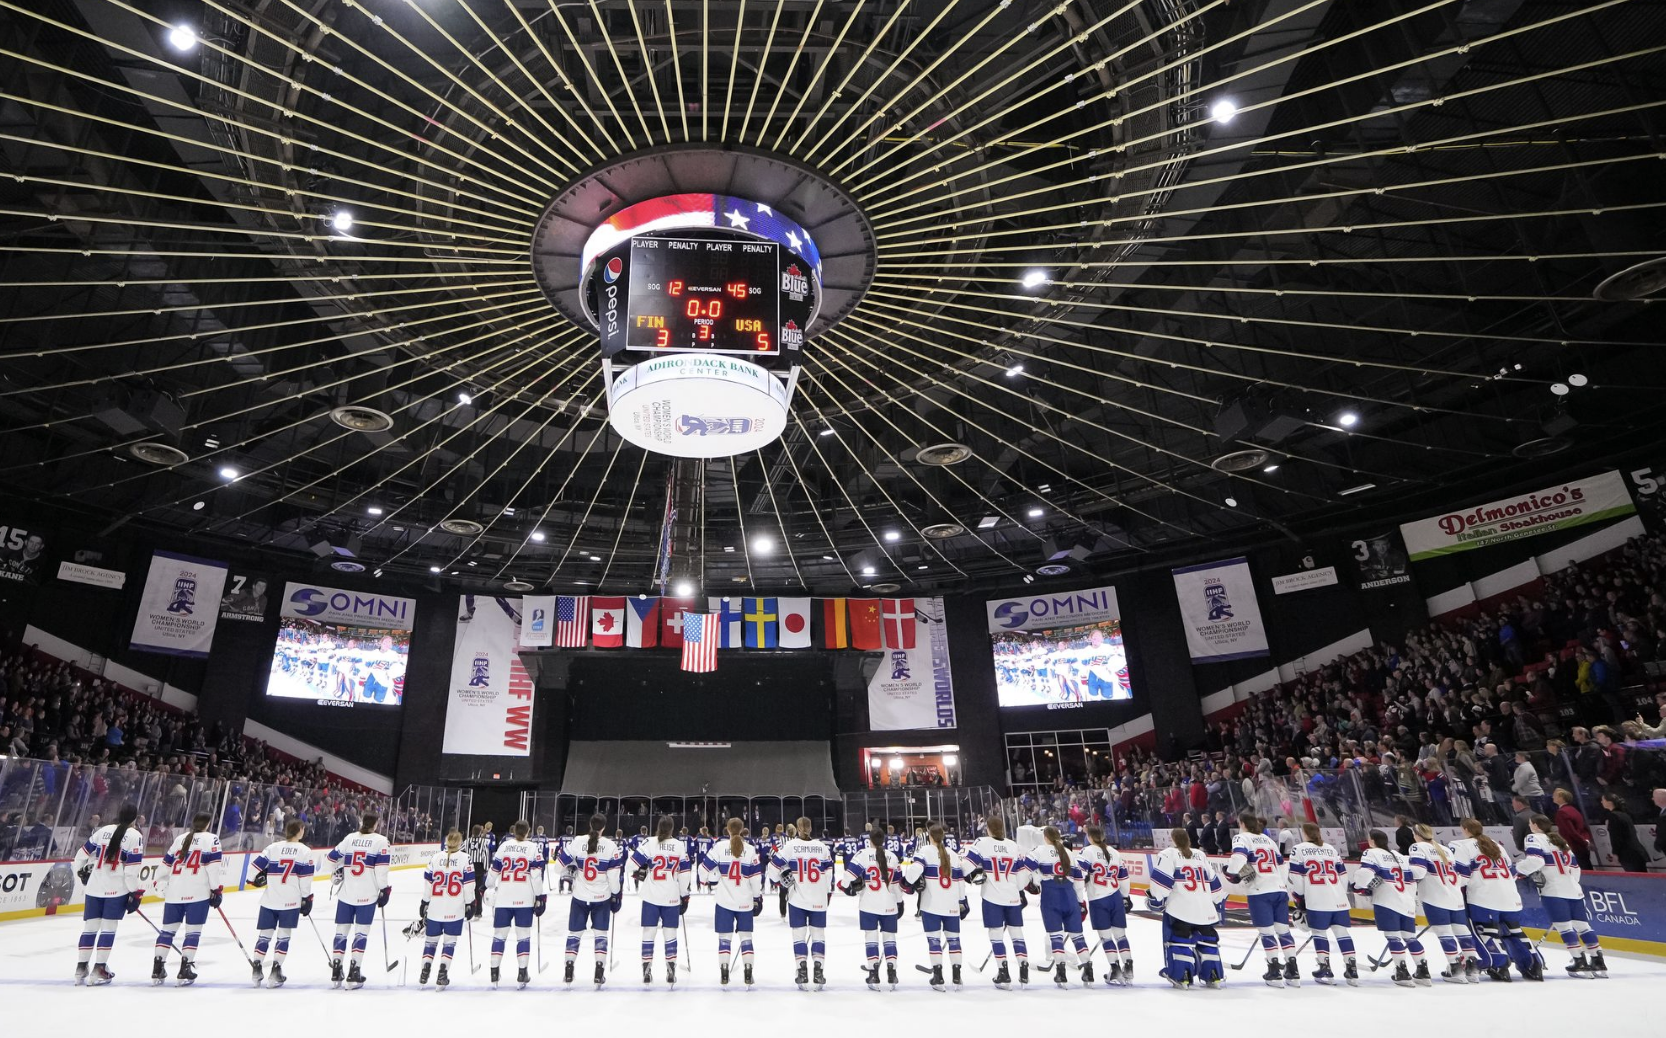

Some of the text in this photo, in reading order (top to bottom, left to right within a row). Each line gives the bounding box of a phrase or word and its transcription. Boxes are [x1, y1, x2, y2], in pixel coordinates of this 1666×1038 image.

[632, 240, 773, 254] PLAYER PENALTY PLAYER PENALTY
[647, 282, 661, 291] SOG
[668, 281, 683, 296] 12
[727, 283, 746, 298] 45
[748, 287, 762, 295] SOG
[782, 272, 808, 295] Blue
[605, 285, 619, 340] pepsi
[636, 315, 665, 329] FIN
[699, 325, 709, 339] 3
[735, 319, 762, 332] USA
[657, 329, 669, 348] 3
[757, 333, 769, 351] 5
[781, 327, 803, 345] Blue
[646, 358, 759, 378] ADIRONDACK BANK
[680, 367, 728, 377] CENTER
[1630, 467, 1658, 495] 5
[1438, 486, 1584, 536] Delmonico's
[1500, 507, 1583, 533] Steakhouse
[1351, 540, 1370, 561] 3
[177, 581, 194, 589] IIHF
[230, 575, 247, 595] 7
[1206, 587, 1223, 596] IIHF
[1361, 574, 1410, 590] ANDERSON
[330, 593, 407, 620] OMNI
[1029, 590, 1108, 617] OMNI
[151, 619, 201, 630] CHAMPIONSHIP
[182, 618, 205, 627] WORLD
[221, 611, 265, 623] ARMSTRONG
[1195, 620, 1251, 632] WOMEN'S WORLD
[1199, 625, 1249, 637] CHAMPIONSHIP
[1635, 696, 1654, 706] 104
[1559, 707, 1575, 717] 103
[351, 839, 373, 848] KELLER
[470, 841, 479, 849] 64
[844, 842, 857, 854] 33
[887, 839, 899, 851] 28
[946, 838, 957, 850] 36
[1301, 847, 1334, 857] CARPENTER
[97, 844, 122, 871] 14
[172, 850, 202, 875] 24
[350, 851, 367, 877] 5
[1255, 848, 1278, 873] 21
[1475, 854, 1510, 879] 29
[278, 858, 295, 885] 7
[501, 856, 529, 882] 22
[583, 856, 599, 882] 6
[652, 855, 680, 881] 27
[728, 860, 742, 886] 4
[797, 857, 821, 883] 16
[991, 856, 1014, 882] 17
[1092, 862, 1119, 888] 23
[1305, 859, 1338, 885] 25
[432, 871, 463, 897] 26
[1181, 866, 1206, 891] 31
[1390, 867, 1405, 892] 3
[1589, 891, 1638, 915] BFL
[1596, 913, 1642, 926] CANADA
